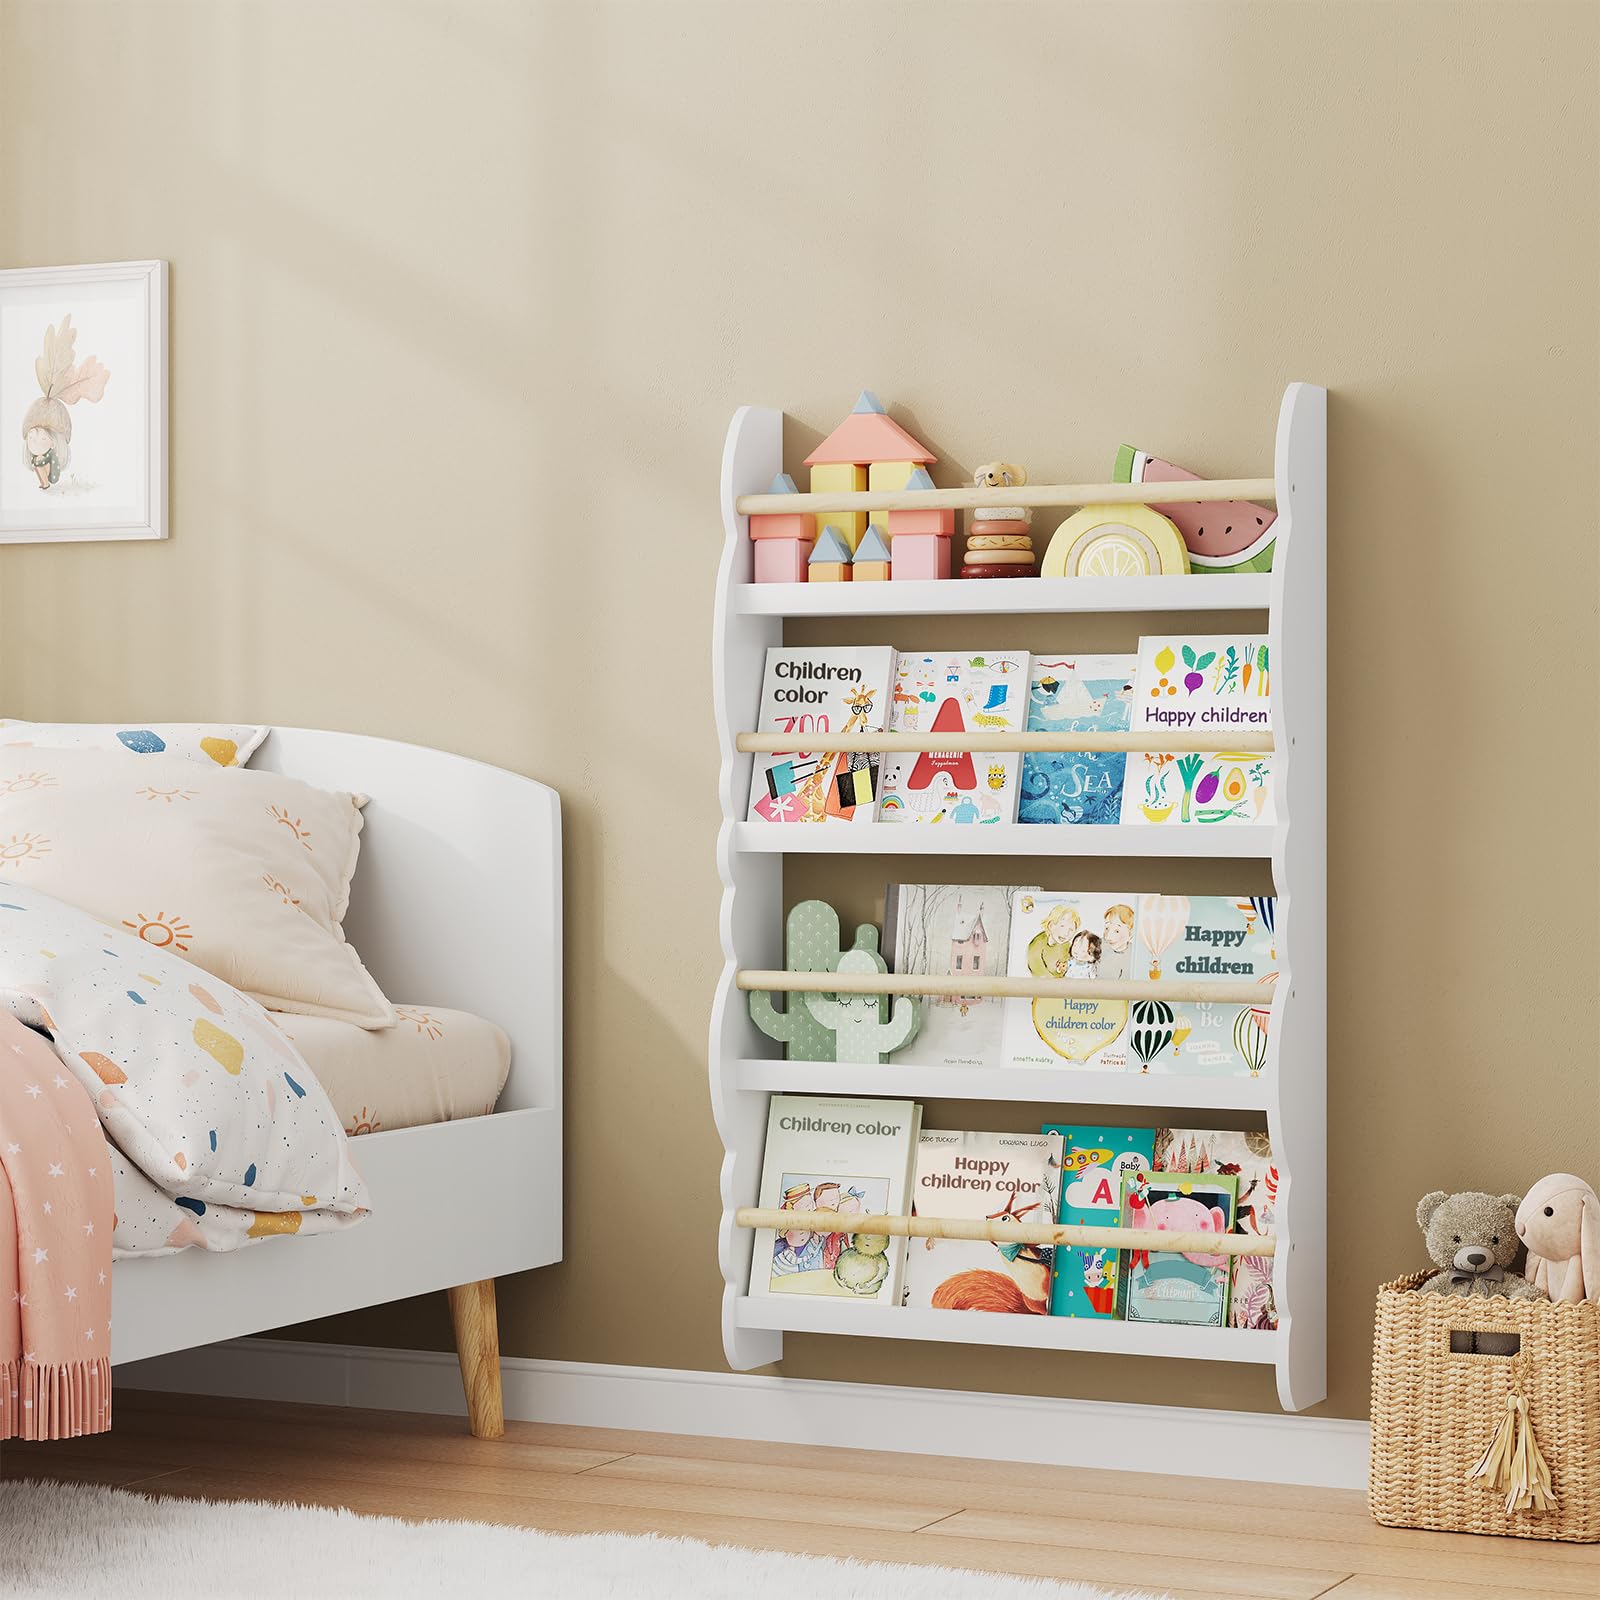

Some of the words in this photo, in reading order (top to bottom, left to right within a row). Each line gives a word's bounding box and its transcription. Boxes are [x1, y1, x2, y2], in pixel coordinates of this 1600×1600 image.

[775, 661, 862, 684] Children
[774, 685, 828, 704] color
[1145, 706, 1197, 727] Happy
[1201, 706, 1268, 723] children
[1184, 925, 1248, 948] Happy
[1175, 955, 1254, 975] children
[1064, 998, 1099, 1015] Happy
[1045, 1016, 1088, 1030] children
[1089, 1017, 1116, 1031] color
[1200, 1011, 1224, 1028] Be
[779, 1116, 852, 1138] Children
[855, 1119, 902, 1137] color
[954, 1156, 1010, 1176] Happy
[1120, 1161, 1141, 1172] Baby
[920, 1173, 992, 1193] children
[995, 1177, 1042, 1194] color
[1091, 1178, 1114, 1205] A
